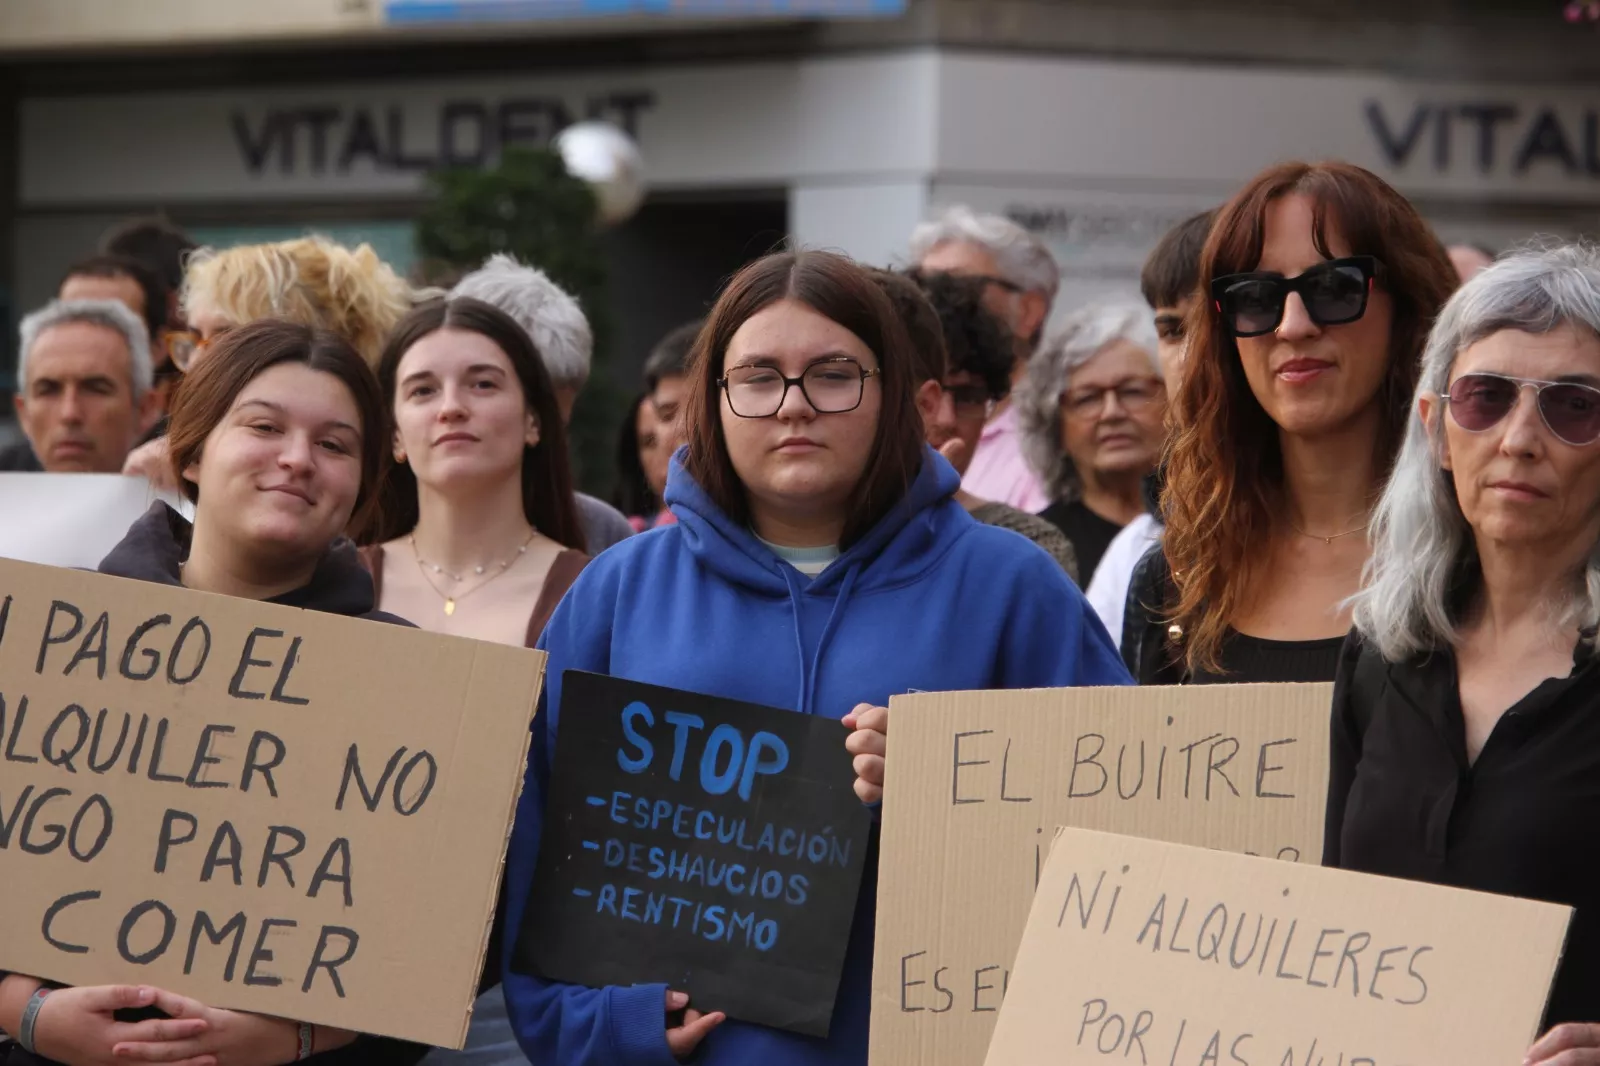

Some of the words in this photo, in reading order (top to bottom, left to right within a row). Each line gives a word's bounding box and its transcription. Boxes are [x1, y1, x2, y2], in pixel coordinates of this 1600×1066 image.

[35, 600, 212, 684] PAGO
[228, 627, 310, 705] EL
[0, 692, 286, 798] LQUILER
[335, 743, 438, 816] NO
[616, 700, 790, 801] STOP
[952, 730, 1032, 806] EL
[154, 808, 353, 907] PARA
[41, 890, 359, 998] COMER
[1077, 998, 1154, 1066] POR
